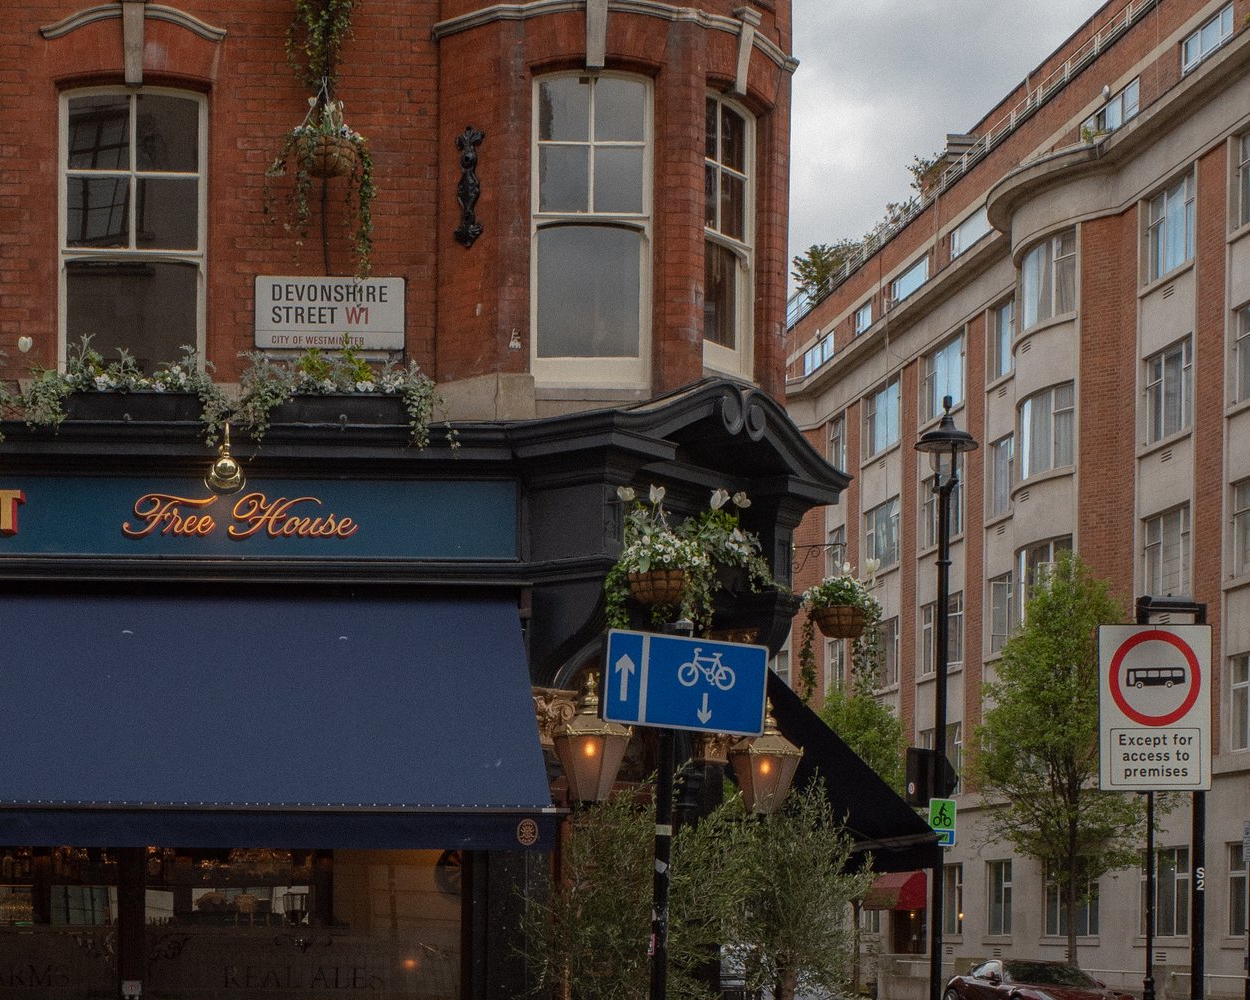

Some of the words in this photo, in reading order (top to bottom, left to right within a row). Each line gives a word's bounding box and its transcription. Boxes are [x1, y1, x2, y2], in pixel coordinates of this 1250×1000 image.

[271, 283, 388, 303] DEVONSHIRE
[271, 305, 338, 324] STREET
[345, 306, 369, 325] W1
[271, 335, 289, 345] CITY
[293, 335, 303, 345] OF
[305, 336, 365, 346] WESTMINTER
[122, 492, 218, 539] Free
[227, 492, 358, 540] House
[1118, 734, 1168, 748] Except
[1173, 734, 1193, 746] for
[1122, 752, 1170, 762] access
[1175, 750, 1190, 762] to
[1124, 765, 1188, 780] premises
